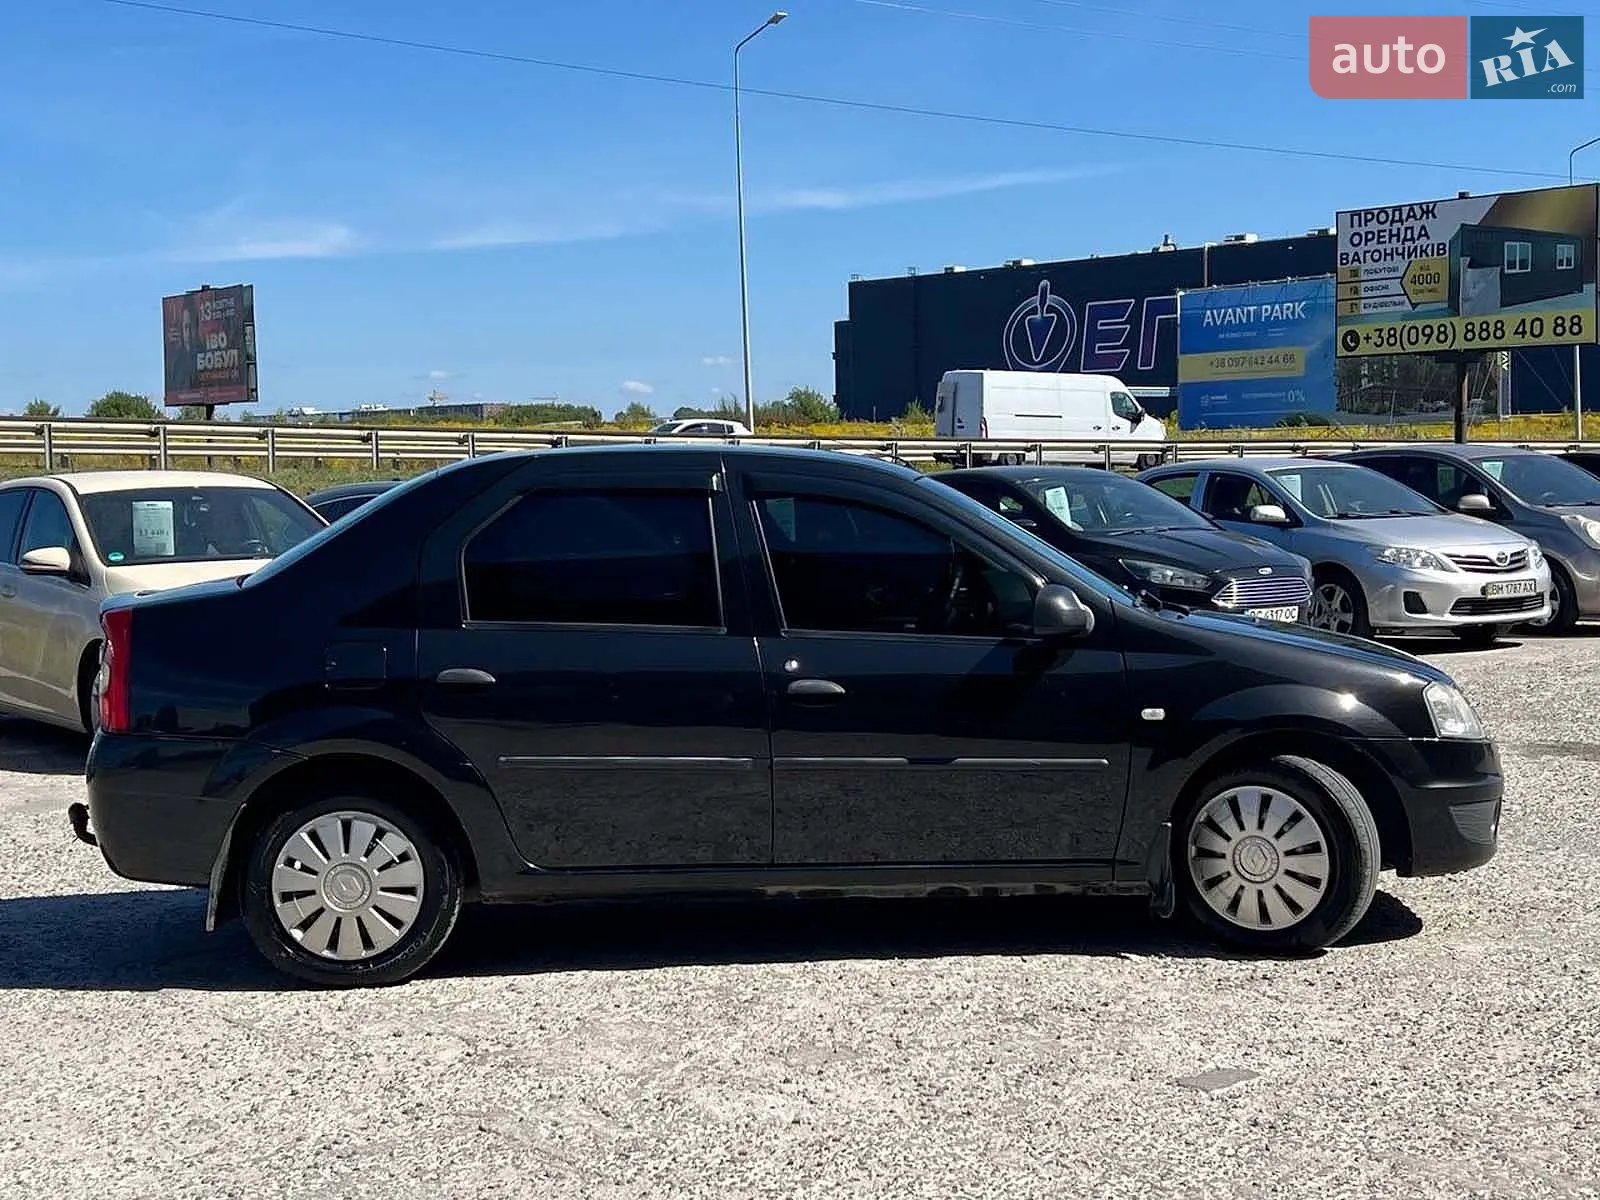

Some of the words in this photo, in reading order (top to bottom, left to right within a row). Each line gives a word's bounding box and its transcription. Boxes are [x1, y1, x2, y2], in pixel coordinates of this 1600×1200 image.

[1350, 203, 1437, 228] ПРОДАЖ
[1349, 225, 1430, 247] ОРЕНДА
[1340, 243, 1447, 266] ВАГОНЧИКІВ
[1410, 272, 1441, 286] 4000
[1202, 306, 1257, 328] AVANT
[1261, 301, 1307, 322] PARK
[1363, 320, 1456, 351] +38(098)
[1463, 319, 1505, 342] 888
[1513, 317, 1544, 339] 40
[1553, 314, 1583, 337] 88
